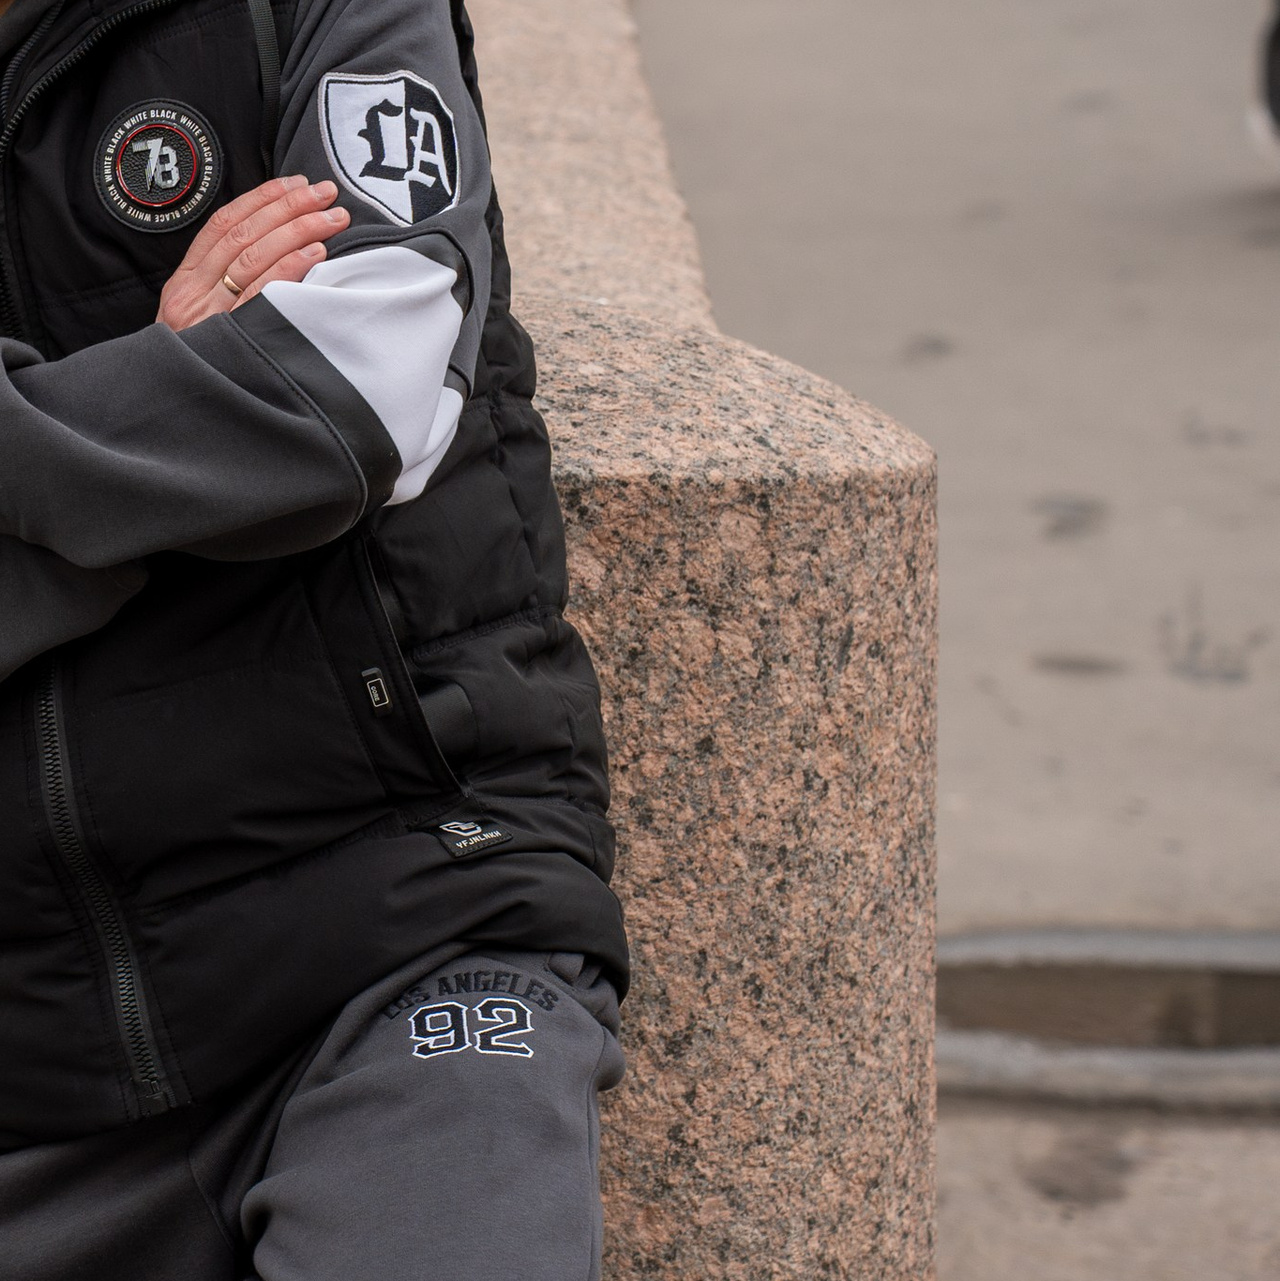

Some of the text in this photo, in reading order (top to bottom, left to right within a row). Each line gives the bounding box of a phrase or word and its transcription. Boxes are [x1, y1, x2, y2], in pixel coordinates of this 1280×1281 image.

[124, 111, 148, 129] WHITE
[150, 109, 177, 120] BLACK
[180, 115, 202, 136] WHITE
[106, 127, 125, 154] BLACK
[199, 136, 213, 162] BLACK
[104, 155, 113, 183] WHITE
[131, 137, 181, 192] 78
[199, 165, 213, 193] BLACK
[107, 184, 128, 209] BLACK
[182, 192, 204, 215] WHITE
[437, 970, 559, 1012] ANGELES
[407, 996, 535, 1059] 92
